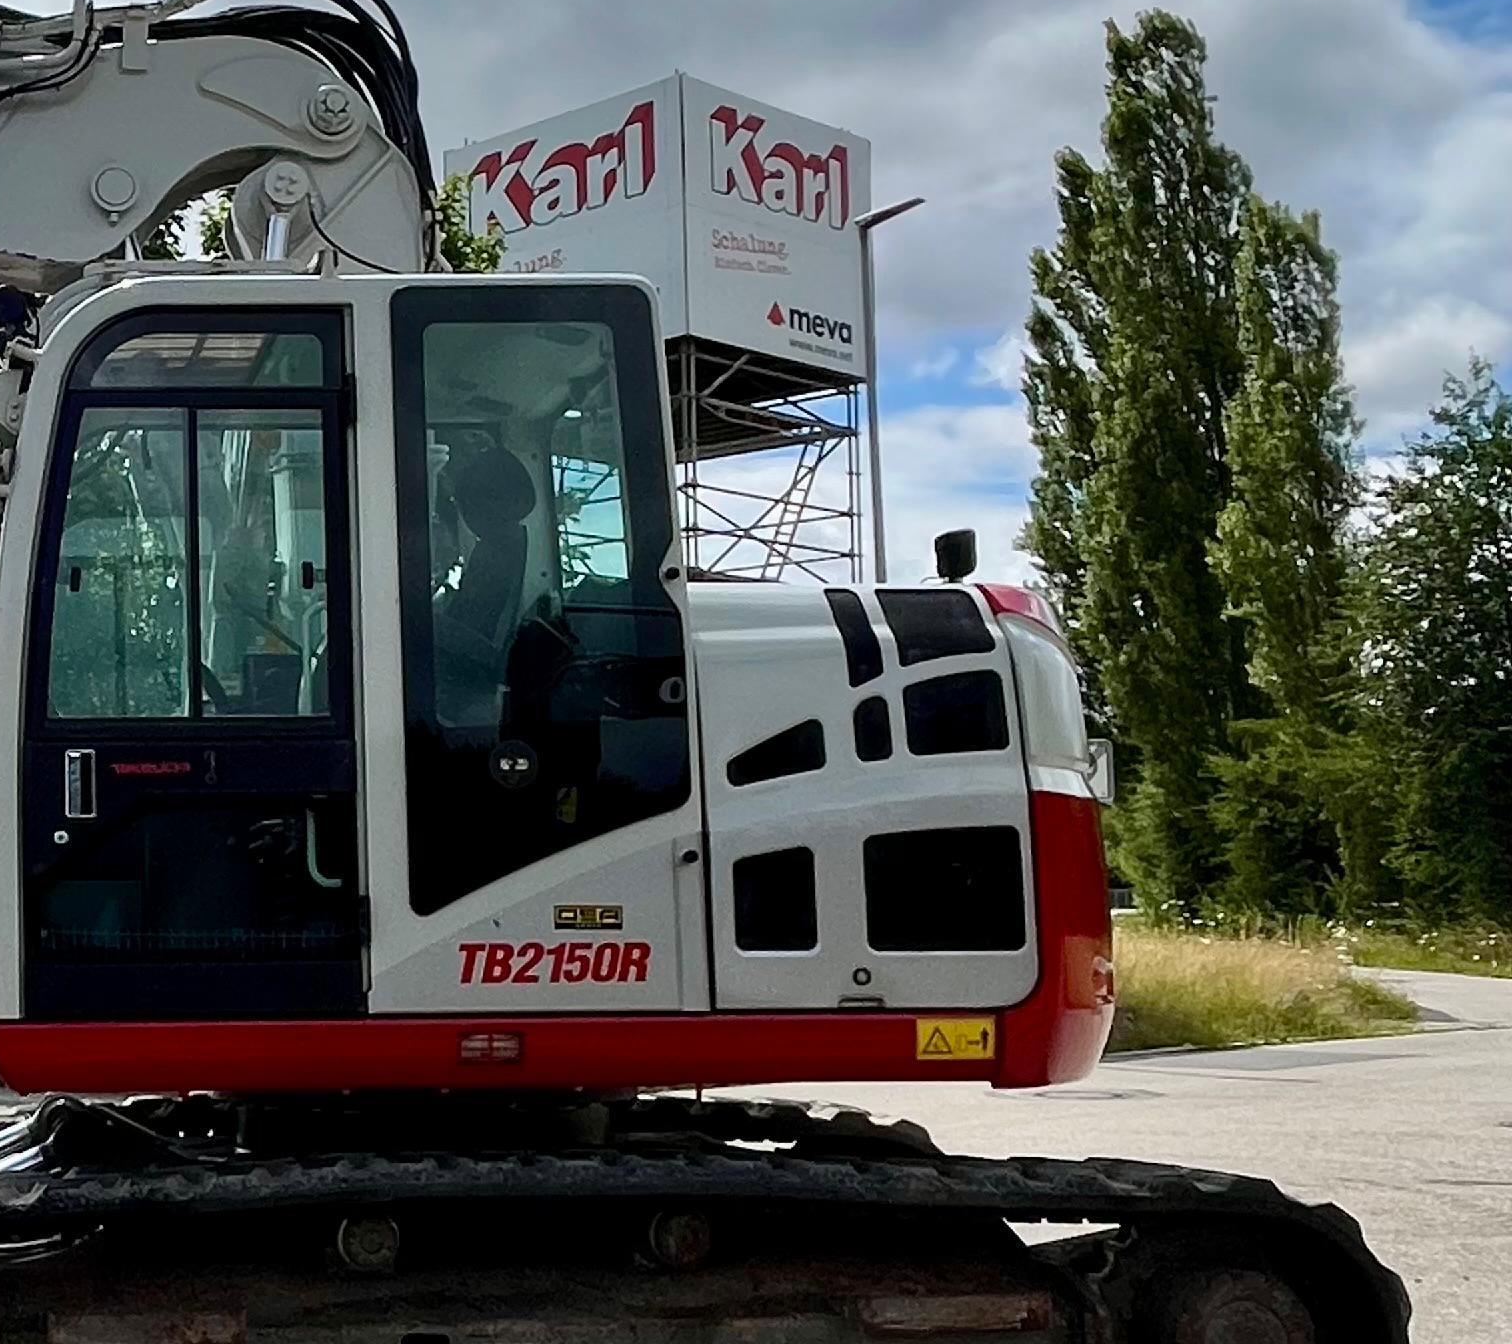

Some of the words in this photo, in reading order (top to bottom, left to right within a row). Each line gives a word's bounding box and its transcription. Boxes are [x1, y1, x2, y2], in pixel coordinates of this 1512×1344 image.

[469, 101, 656, 235] Karl
[710, 105, 849, 231] Karl
[789, 308, 852, 344] meva
[459, 943, 651, 984] TB2150R
